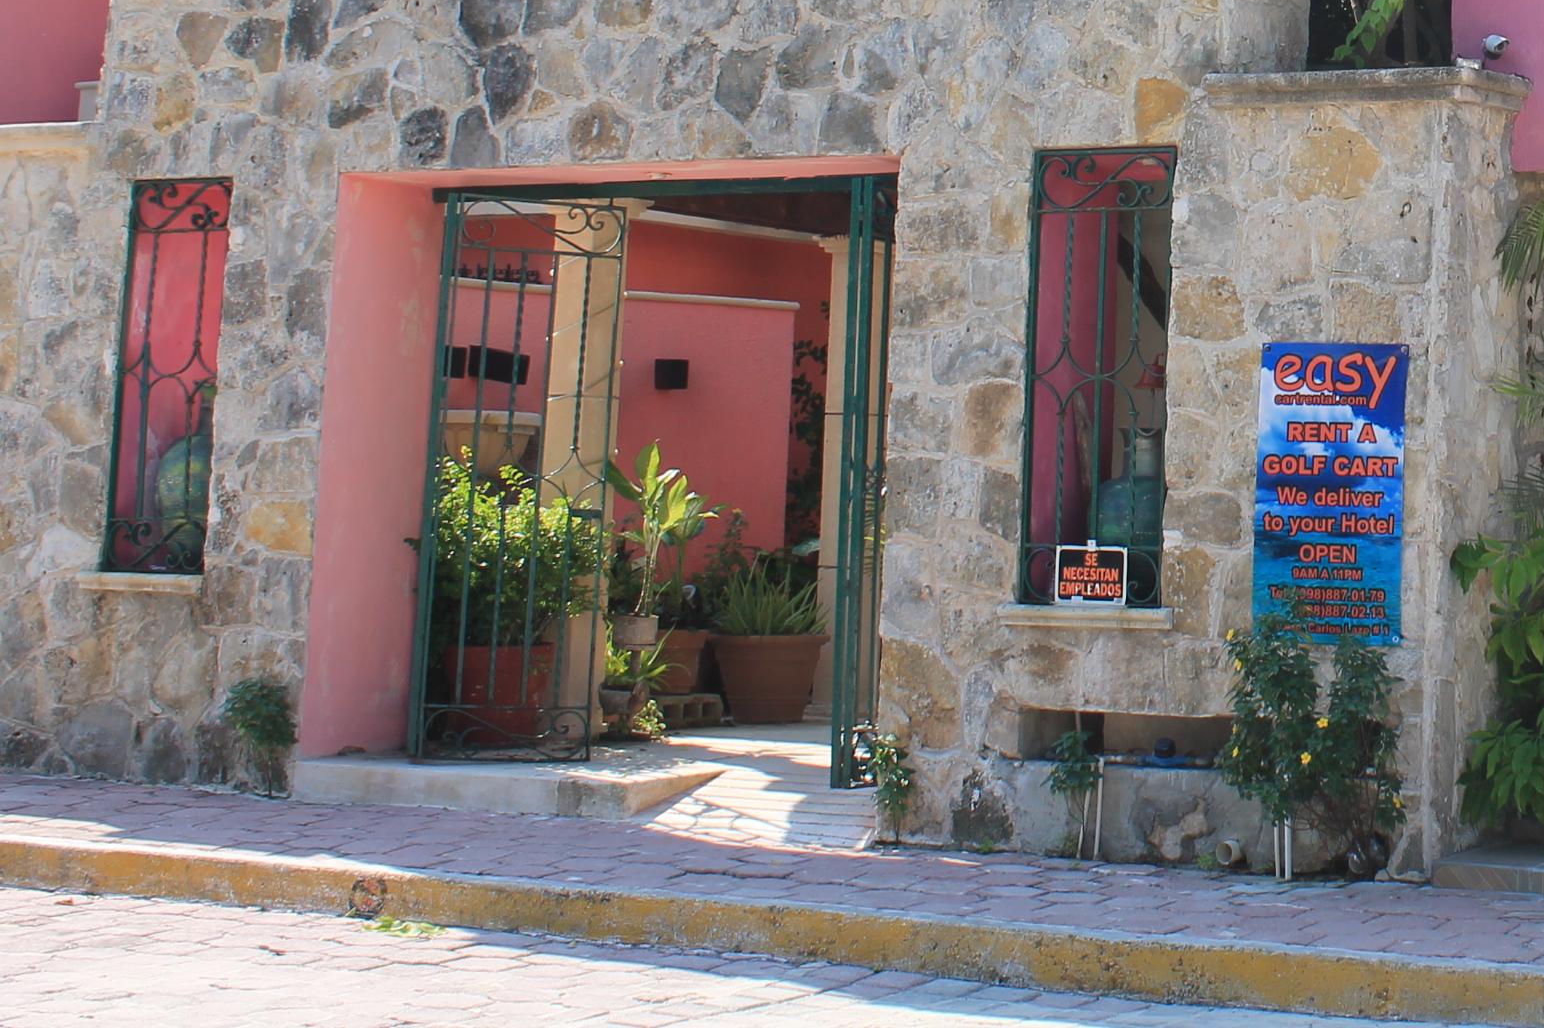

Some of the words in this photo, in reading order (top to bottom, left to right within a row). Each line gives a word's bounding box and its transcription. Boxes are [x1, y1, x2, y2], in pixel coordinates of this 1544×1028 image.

[1274, 352, 1397, 409] easy
[1274, 393, 1368, 406] cartrental.com
[1287, 422, 1352, 442] RENT
[1357, 423, 1377, 443] A
[1263, 455, 1327, 475] GOLF
[1333, 455, 1398, 477] CART
[1276, 485, 1308, 506] We
[1314, 486, 1383, 508] deliver
[1263, 511, 1284, 531] to
[1289, 515, 1336, 536] your
[1341, 513, 1394, 535] Hotel
[1085, 553, 1098, 566] SE
[1299, 543, 1357, 564] OPEN
[1063, 567, 1119, 581] NECESITAN
[1292, 567, 1318, 580] 9AM
[1319, 569, 1330, 580] A
[1333, 569, 1363, 581] 11PM
[1060, 581, 1121, 597] EMPLEADOS
[1307, 622, 1342, 635] Carlos
